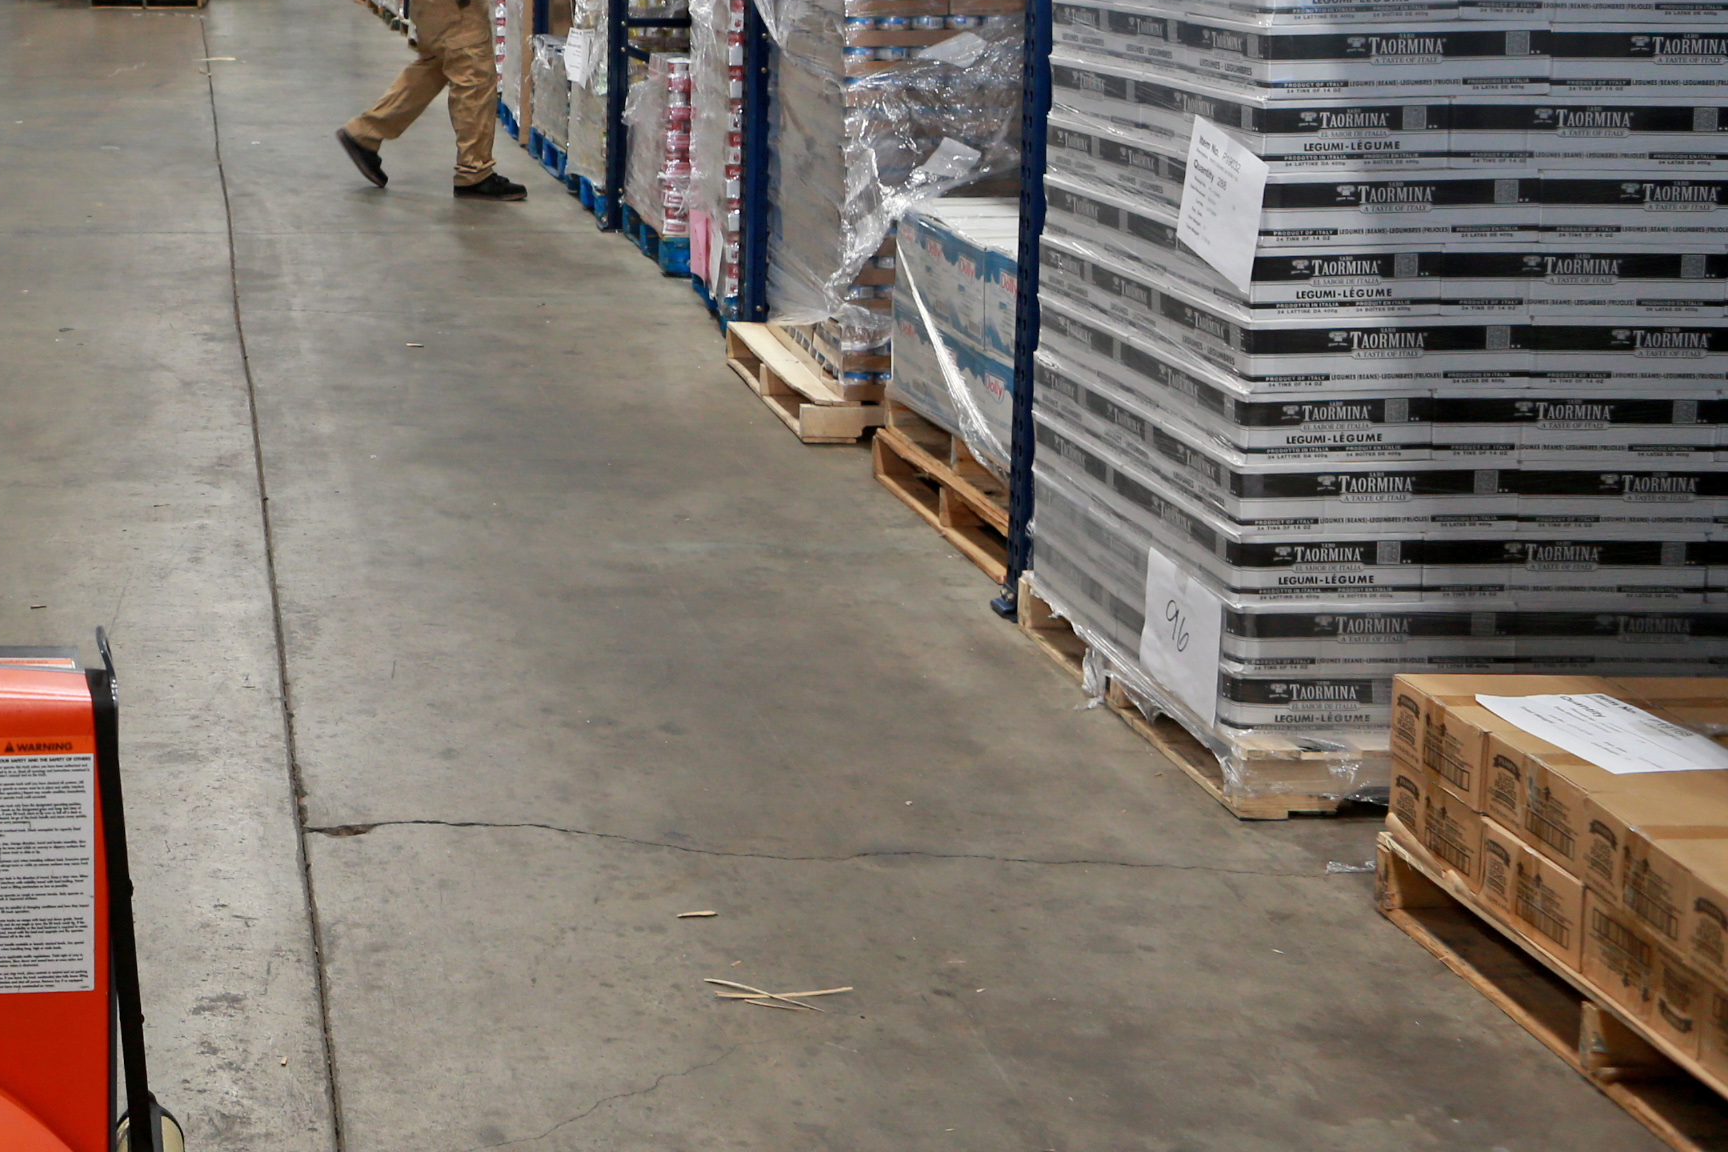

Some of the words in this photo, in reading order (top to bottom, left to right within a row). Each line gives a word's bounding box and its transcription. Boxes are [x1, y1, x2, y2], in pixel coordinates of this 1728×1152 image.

[1369, 37, 1443, 55] TAORMINA
[1653, 36, 1727, 55] TAORMINA
[1320, 111, 1387, 128] TAORMINA
[1556, 109, 1631, 128] TAORMINA
[1194, 159, 1214, 183] Quantity
[1358, 186, 1432, 204] TAORMINA
[1643, 184, 1718, 202] TAORMINA
[1312, 260, 1379, 276] TAORMINA
[1544, 257, 1619, 275] TAORMINA
[1350, 331, 1424, 350] TAORMINA
[1633, 330, 1708, 348] TAORMINA
[985, 373, 1004, 400] Dolly
[1302, 405, 1369, 422] TAORMINA
[1536, 402, 1611, 420] TAORMINA
[1338, 476, 1413, 493] TAORMINA
[1622, 475, 1697, 493] TAORMINA
[1295, 547, 1361, 563] TAORMINA
[1525, 543, 1599, 561] TAORMINA
[1166, 599, 1189, 652] 96
[1336, 617, 1409, 634] TAORMINA
[1289, 684, 1357, 700] TAORMINA
[17, 743, 72, 751] WARNING
